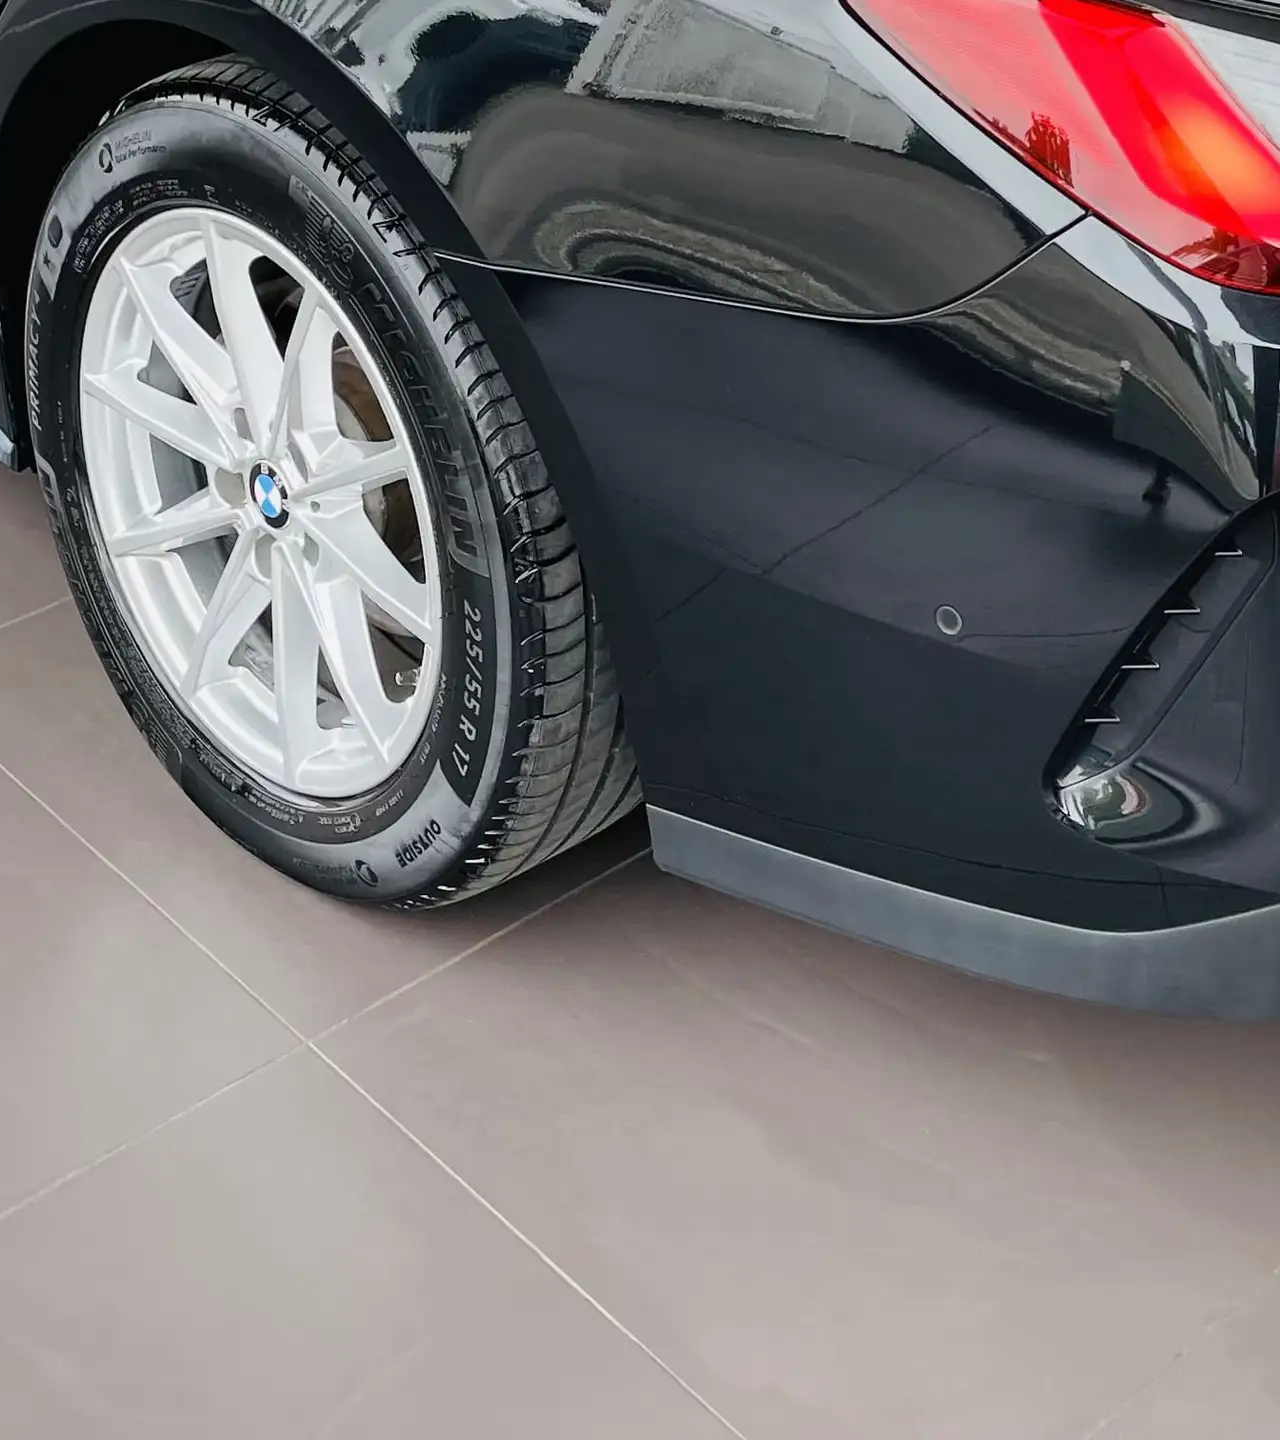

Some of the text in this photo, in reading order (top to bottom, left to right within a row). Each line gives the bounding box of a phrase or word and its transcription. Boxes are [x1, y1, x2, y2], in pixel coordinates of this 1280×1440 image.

[26, 306, 43, 431] PRIMACY
[451, 598, 484, 779] 225/55 R 17
[395, 818, 442, 869] OUTSIDE
